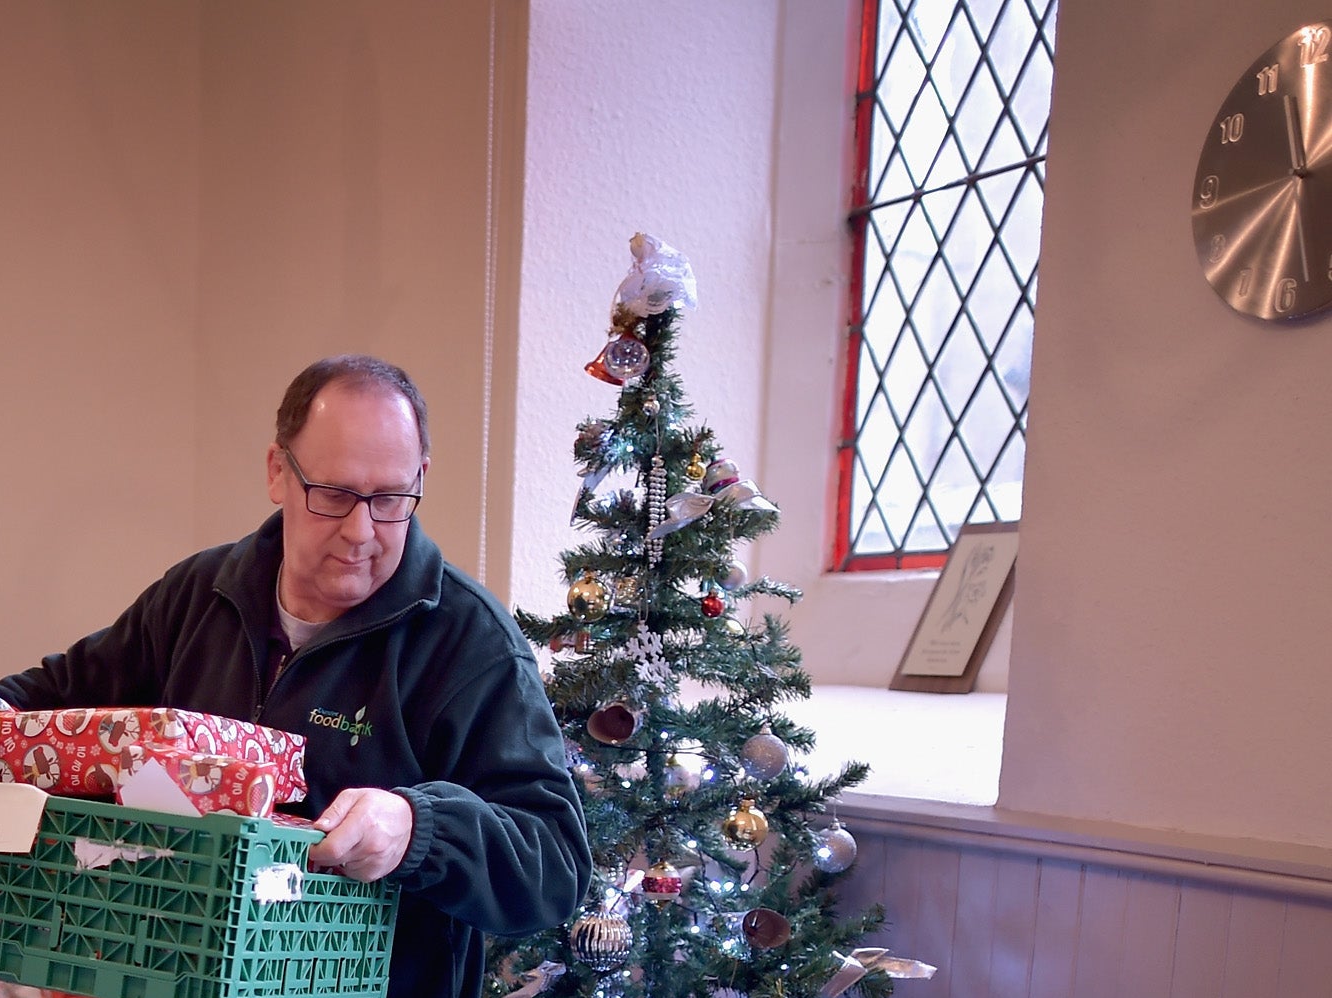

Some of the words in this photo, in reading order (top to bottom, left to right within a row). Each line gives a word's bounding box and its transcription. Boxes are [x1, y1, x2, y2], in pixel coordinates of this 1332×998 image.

[1297, 26, 1332, 66] 12
[1257, 63, 1280, 96] 11
[1220, 113, 1244, 144] 10
[1200, 175, 1220, 210] 9
[1209, 234, 1226, 264] 8
[1275, 278, 1297, 313] 6
[1, 721, 13, 735] HO
[309, 709, 373, 736] foodbank
[3, 736, 16, 752] HO
[76, 746, 86, 758] HO
[71, 759, 83, 772] HO
[235, 767, 249, 781] HO
[71, 774, 80, 786] HO
[232, 782, 243, 795] HO
